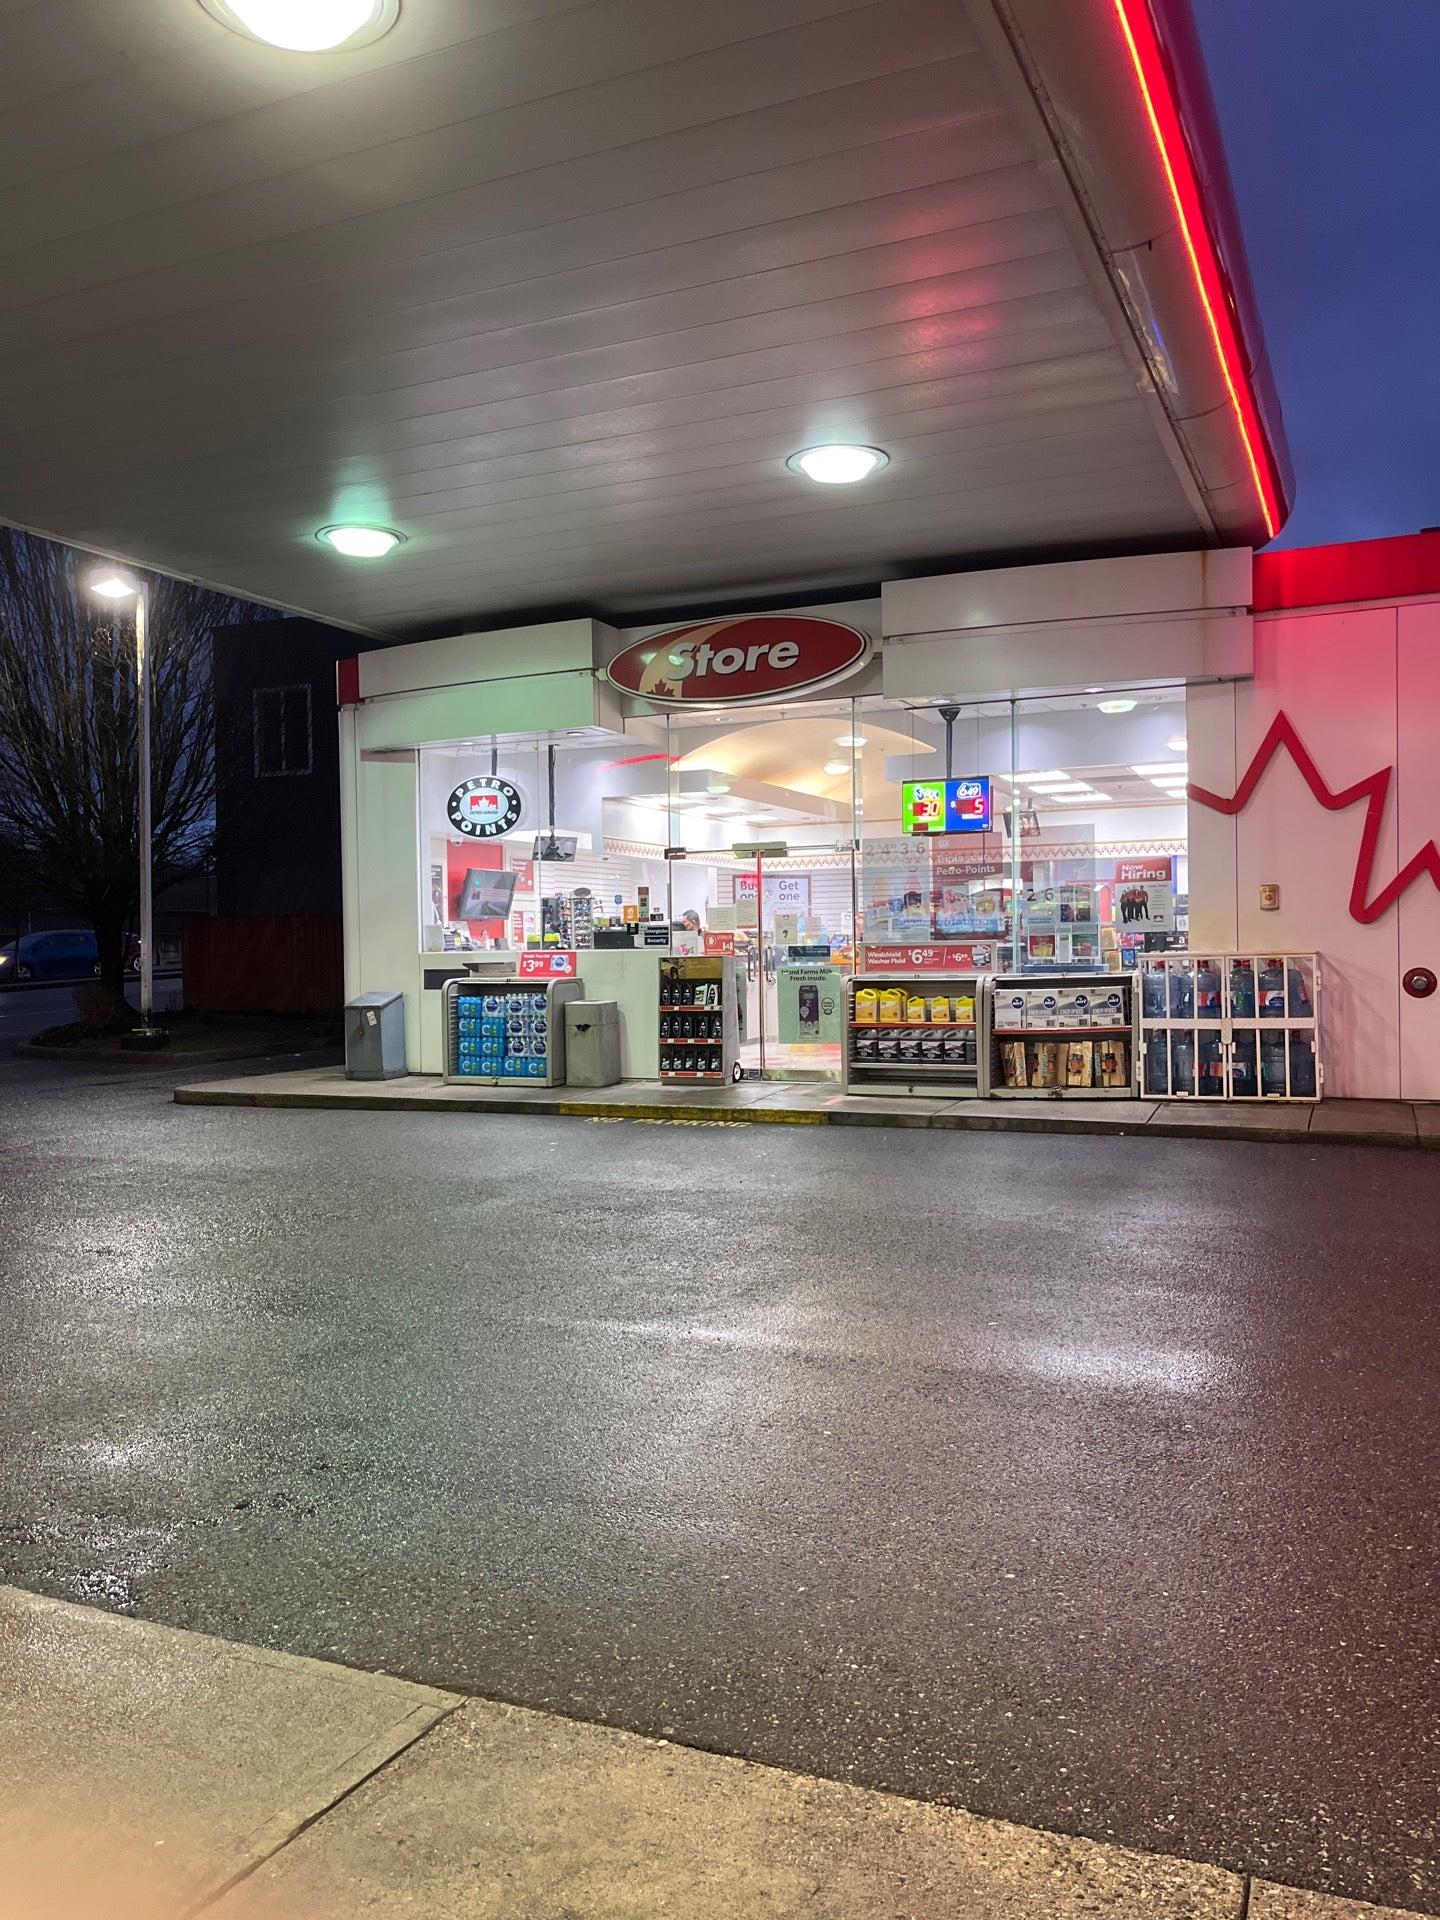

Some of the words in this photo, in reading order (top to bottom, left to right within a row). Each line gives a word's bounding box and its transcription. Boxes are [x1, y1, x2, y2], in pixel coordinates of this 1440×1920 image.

[667, 641, 800, 681] Store
[455, 779, 514, 798] PETRO
[451, 810, 517, 836] POINTS
[936, 866, 996, 875] Petro-Points
[1121, 869, 1166, 880] Hiring
[778, 880, 799, 891] Get
[779, 892, 800, 901] one
[633, 1118, 752, 1128] PARKING
